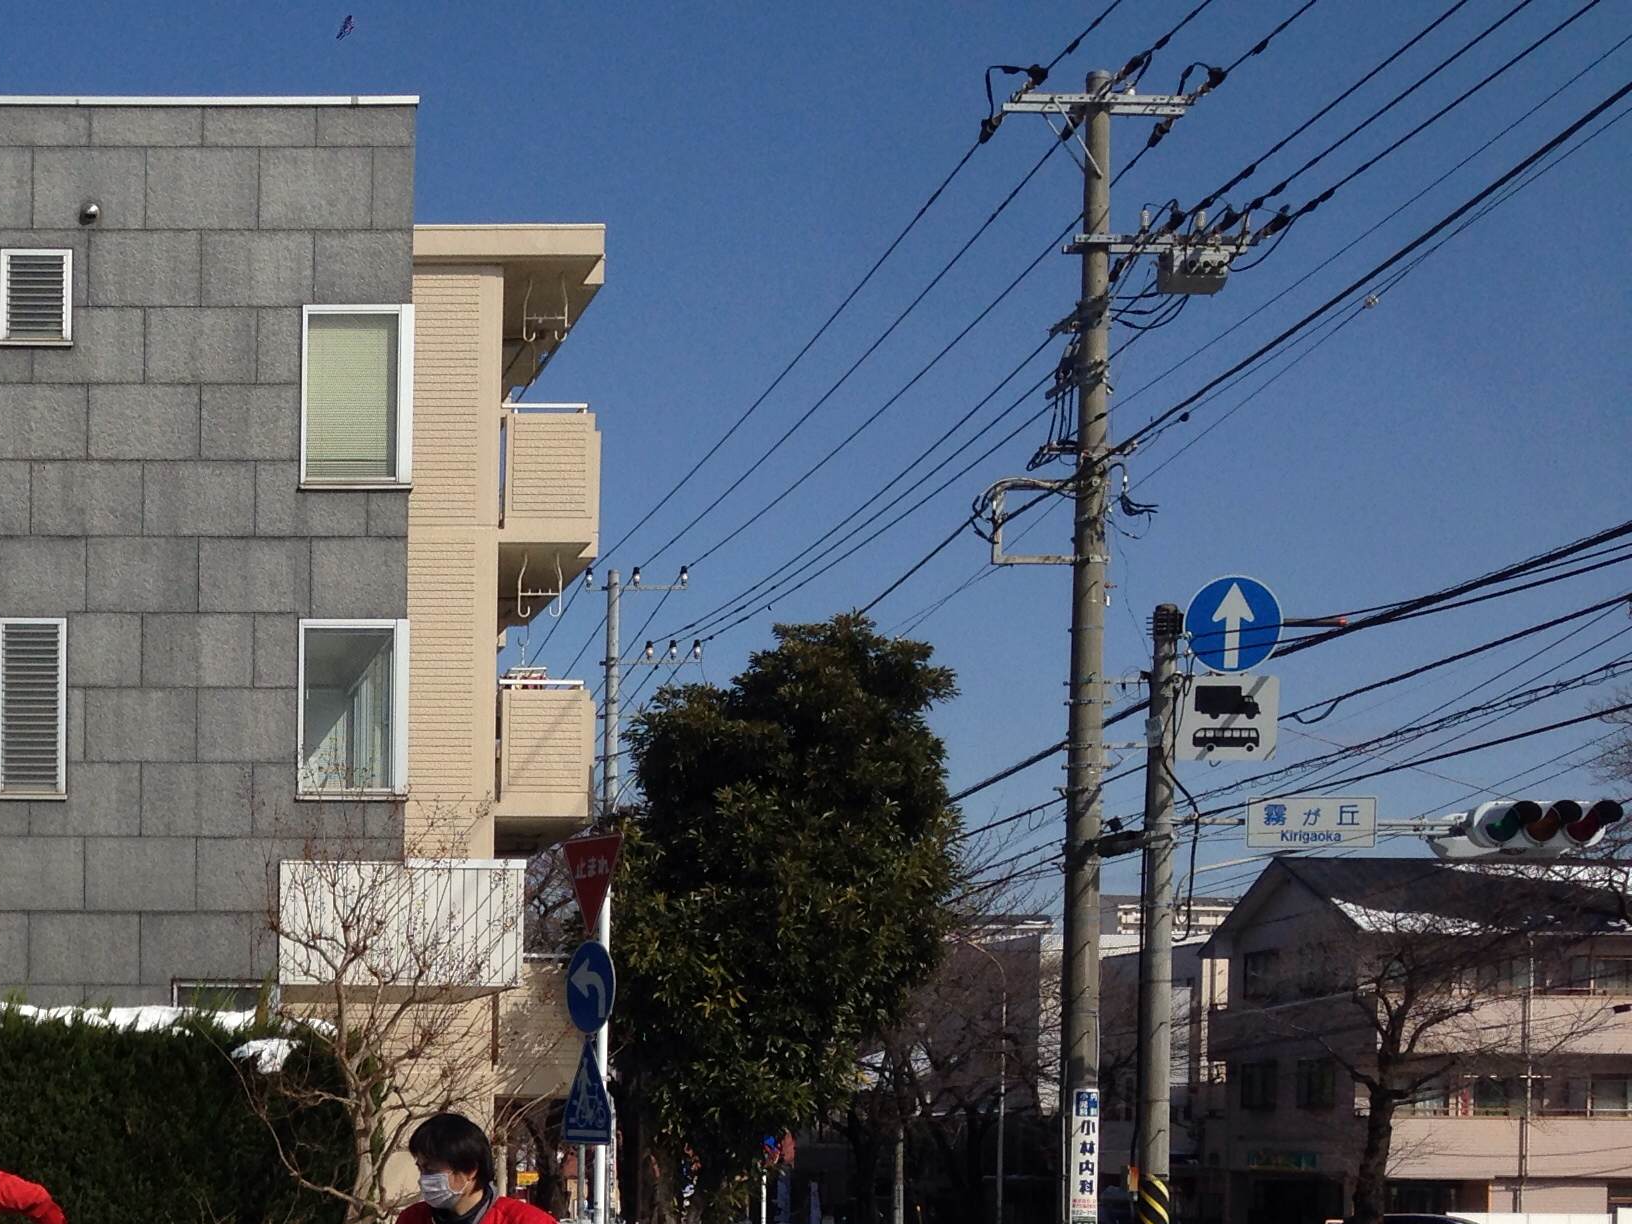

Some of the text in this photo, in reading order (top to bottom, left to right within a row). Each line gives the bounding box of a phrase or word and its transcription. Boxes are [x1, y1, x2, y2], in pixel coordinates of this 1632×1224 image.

[1264, 803, 1360, 826] 霧が丘
[1280, 829, 1342, 844] Kirigaoka
[574, 855, 609, 879] 止まれ
[1079, 1119, 1096, 1195] 小林内科
